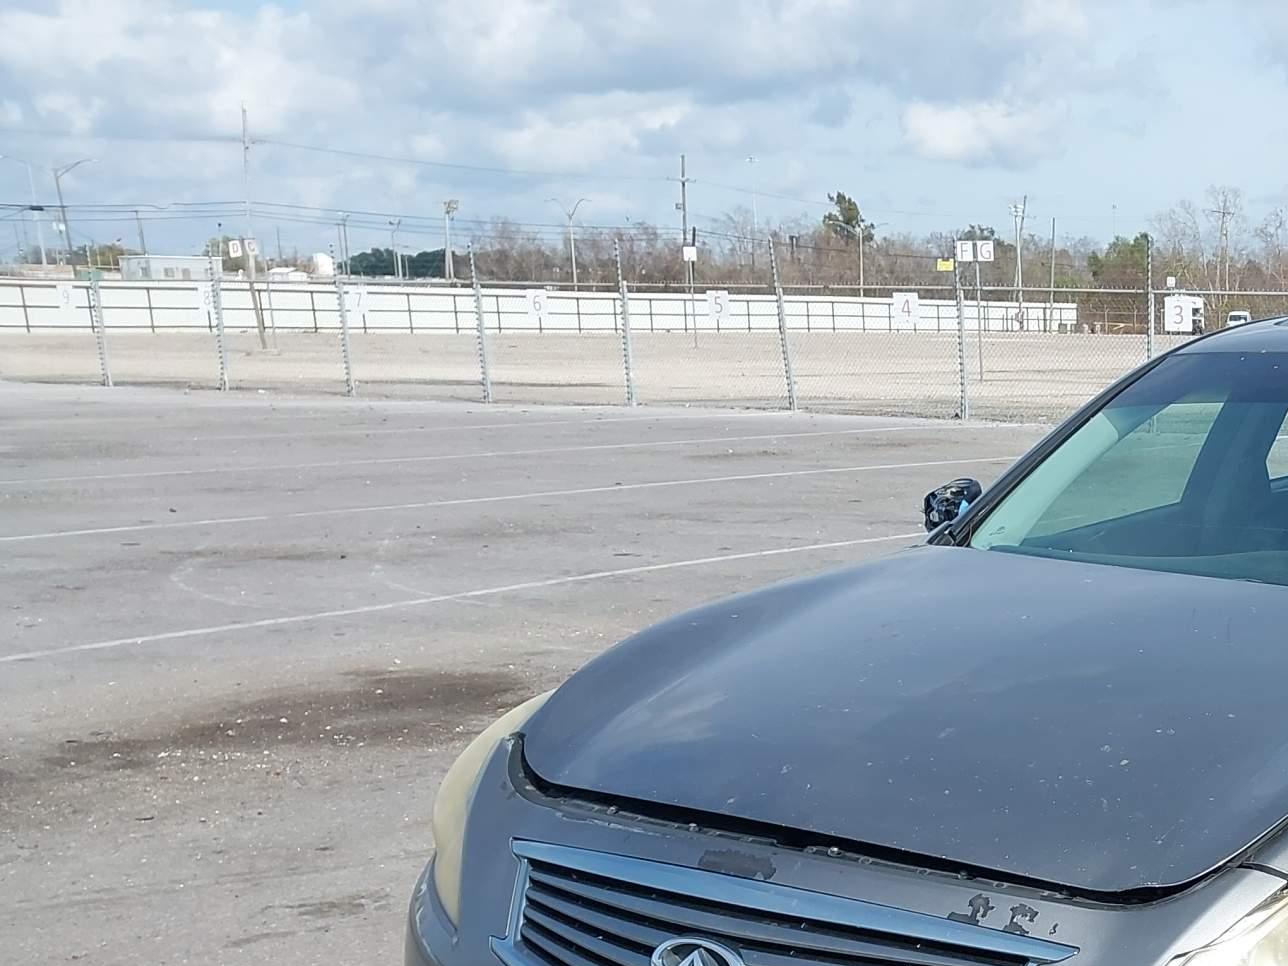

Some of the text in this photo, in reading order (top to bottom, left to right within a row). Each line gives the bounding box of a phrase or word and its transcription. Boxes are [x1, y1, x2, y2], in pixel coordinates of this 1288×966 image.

[231, 243, 238, 253] D
[247, 242, 255, 252] C
[961, 243, 968, 260] F
[980, 243, 992, 260] G
[63, 290, 69, 304] 9
[203, 290, 211, 305] 8
[354, 292, 362, 308] 7
[533, 295, 541, 312] 6
[715, 296, 723, 314] 5
[901, 298, 912, 317] 4
[1173, 305, 1184, 325] 3
